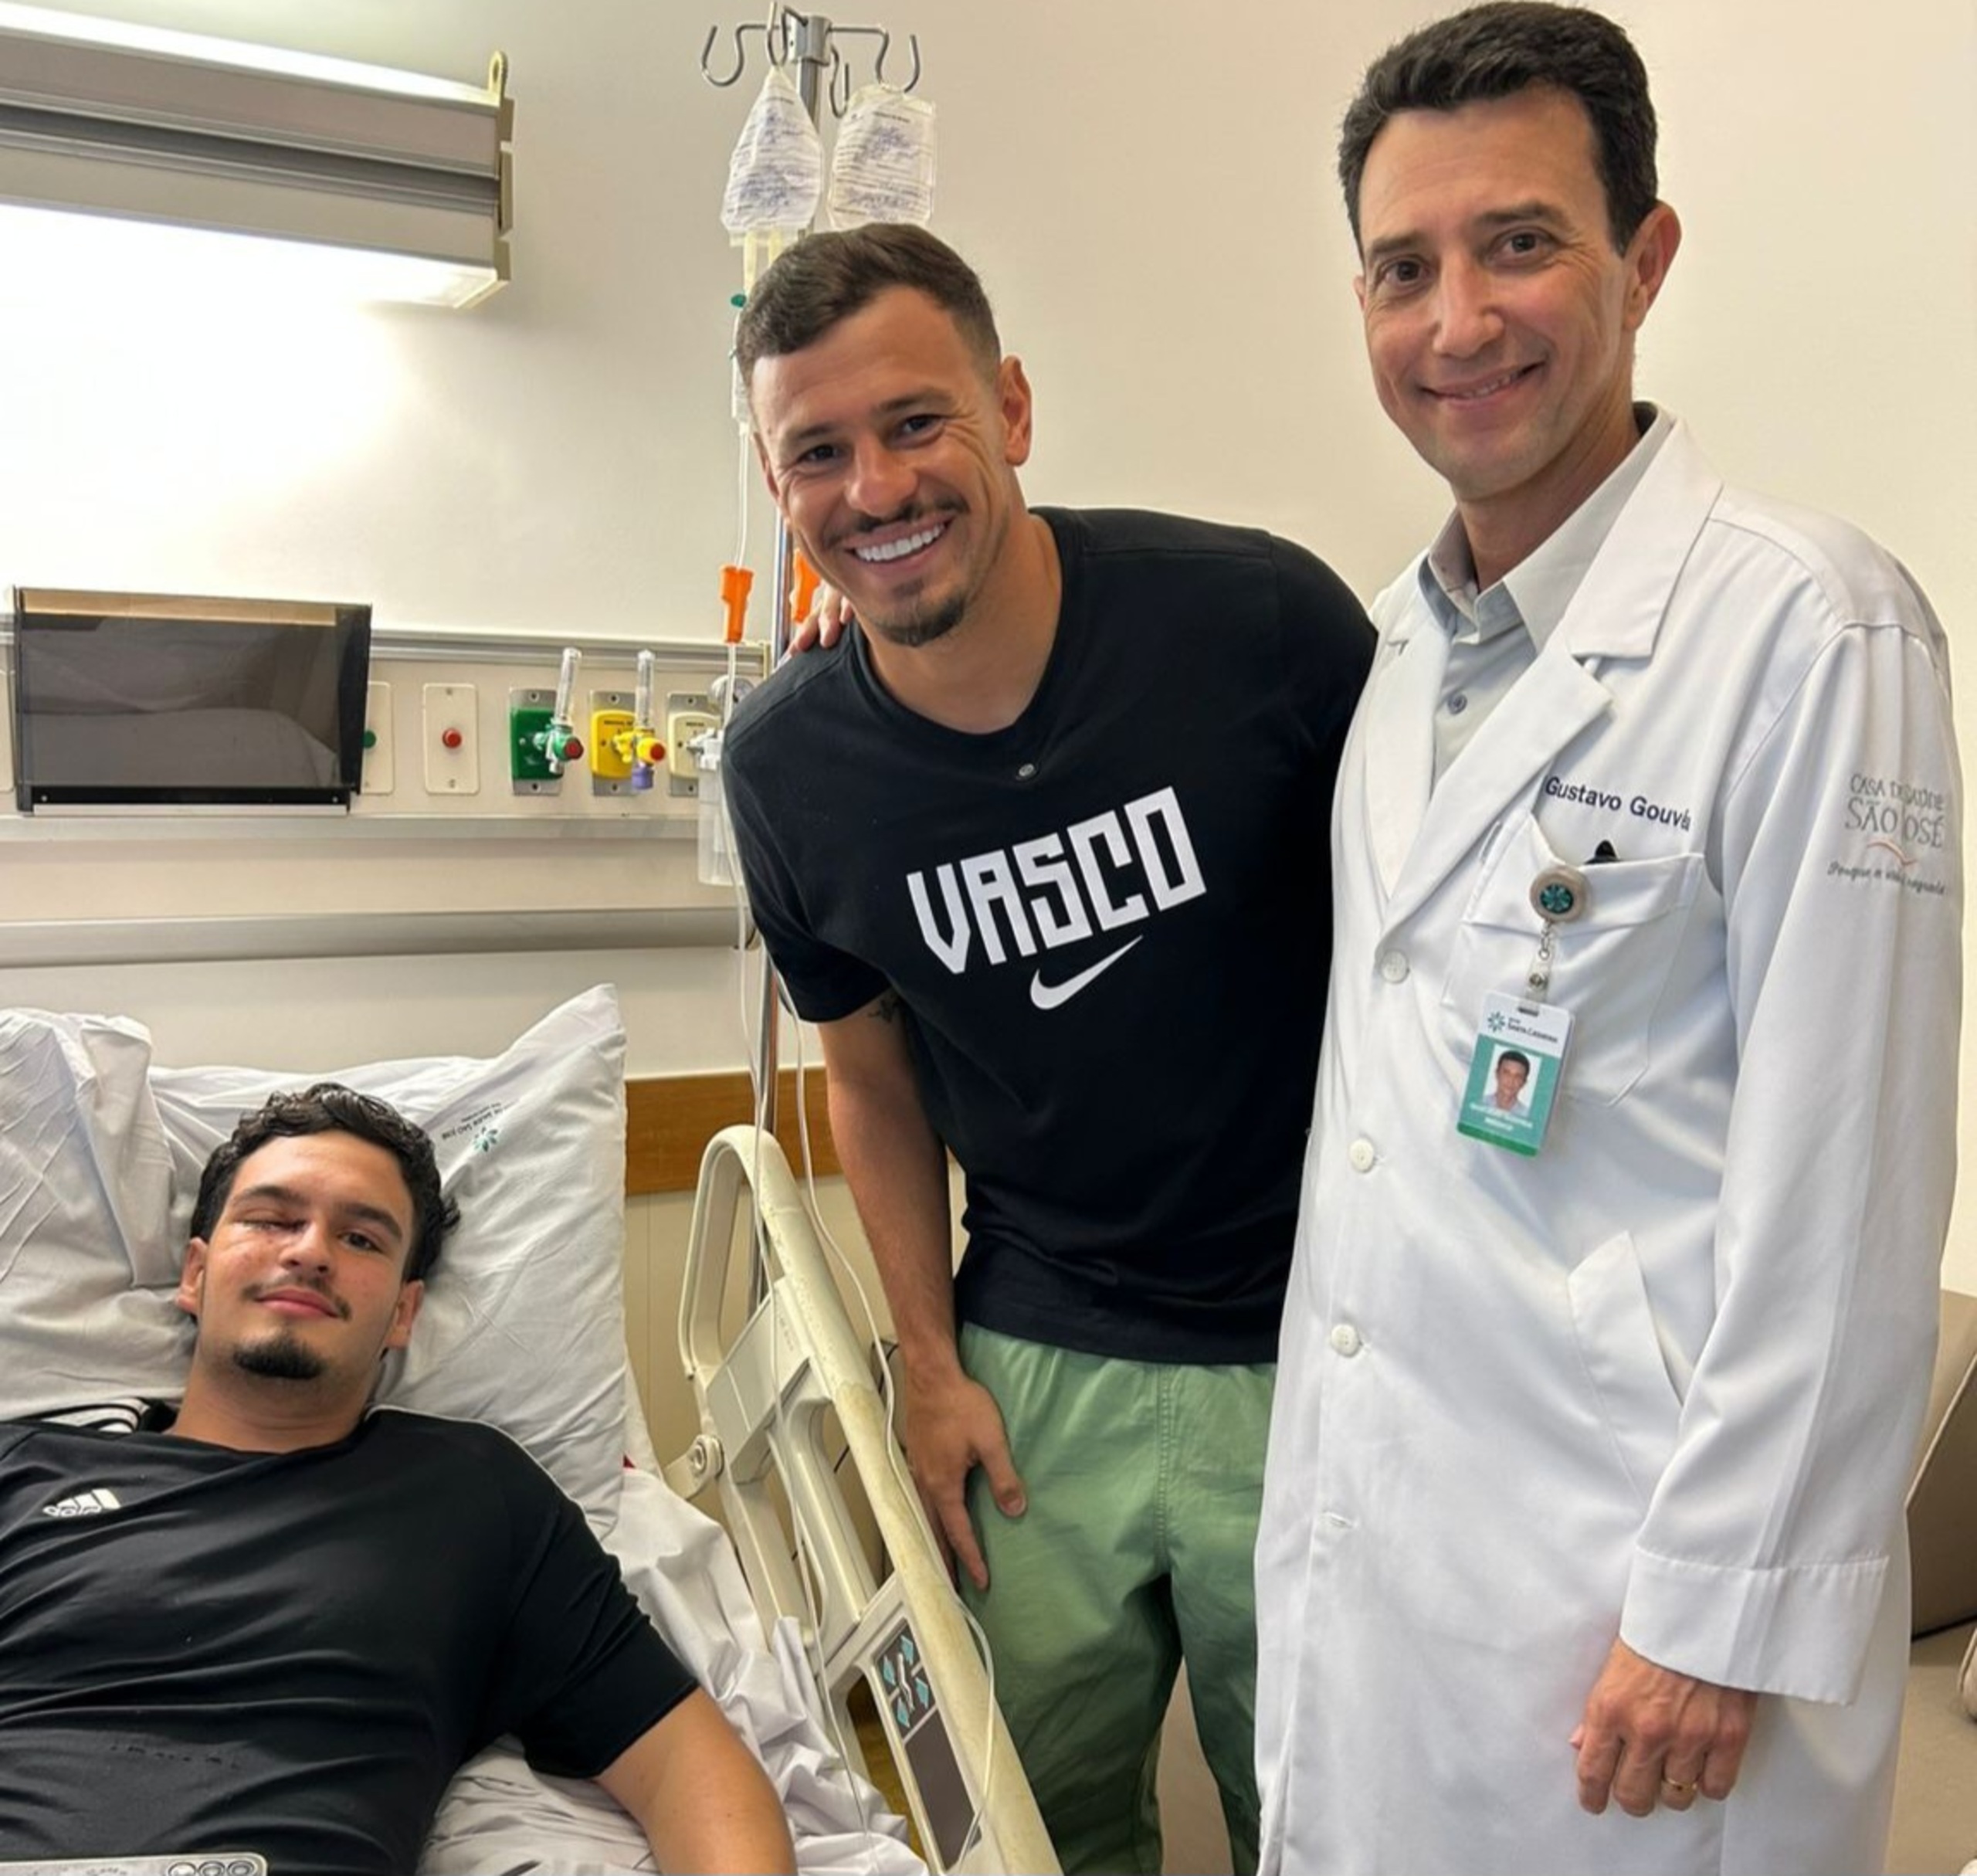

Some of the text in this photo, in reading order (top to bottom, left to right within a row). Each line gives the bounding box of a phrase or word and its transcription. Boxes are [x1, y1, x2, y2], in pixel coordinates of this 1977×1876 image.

[1545, 775, 1622, 811] Gustavo
[1850, 773, 1885, 797] CASA
[1845, 796, 1898, 834] SÃO
[907, 785, 1207, 975] VASCO
